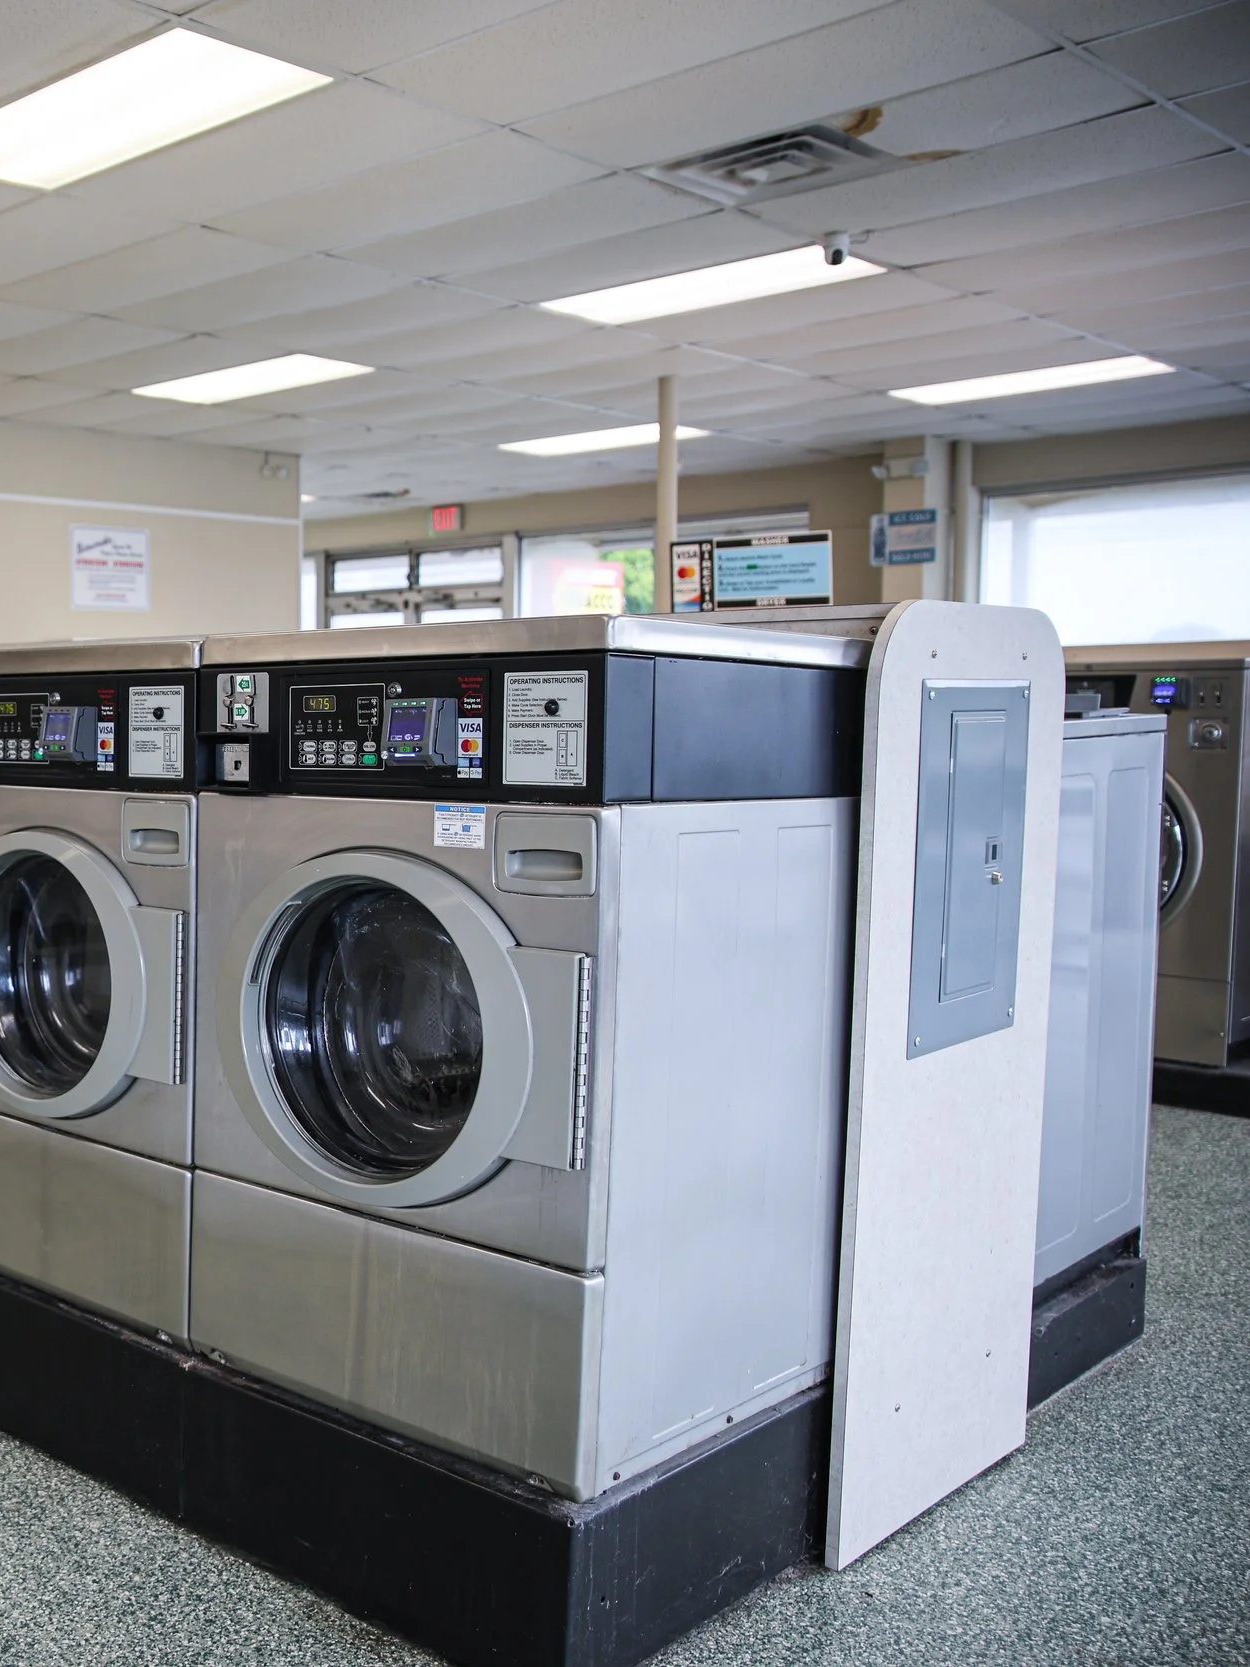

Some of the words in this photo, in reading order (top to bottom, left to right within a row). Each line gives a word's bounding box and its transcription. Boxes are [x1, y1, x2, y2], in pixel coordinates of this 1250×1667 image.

[676, 551, 698, 559] VISA
[310, 698, 330, 710] 475
[99, 726, 114, 734] VISA
[460, 723, 481, 732] VISA
